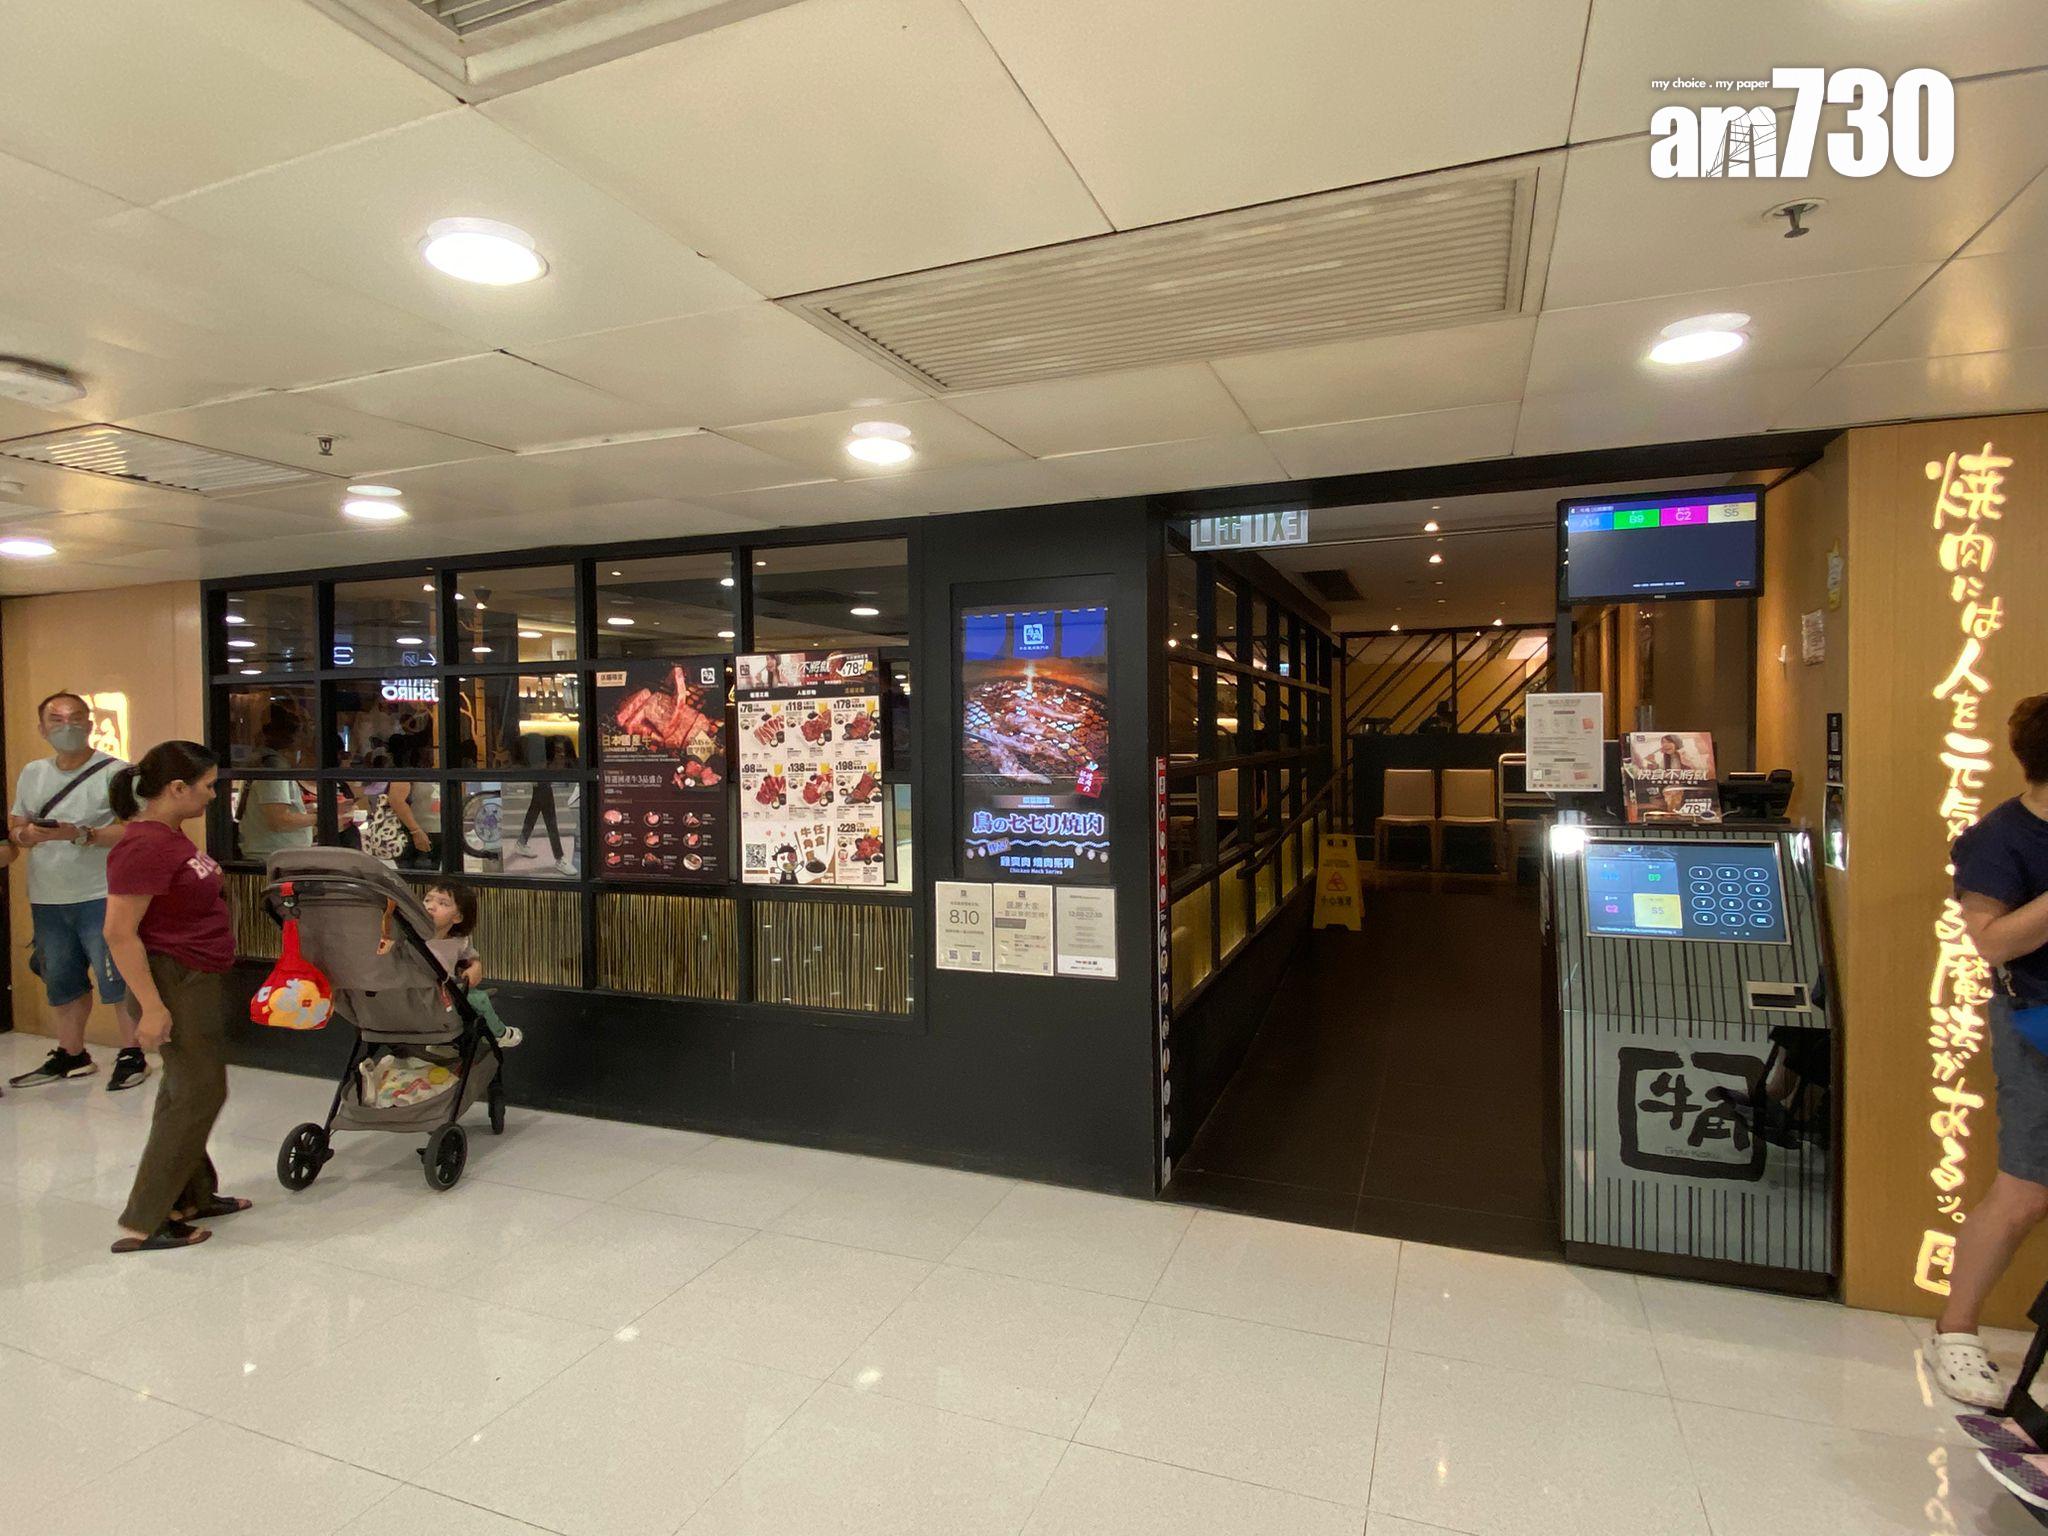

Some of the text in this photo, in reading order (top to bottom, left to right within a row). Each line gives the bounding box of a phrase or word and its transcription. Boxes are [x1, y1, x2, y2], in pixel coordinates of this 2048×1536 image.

[1675, 511, 1692, 521] C2
[1724, 508, 1740, 517] S5
[949, 909, 980, 925] 8.10
